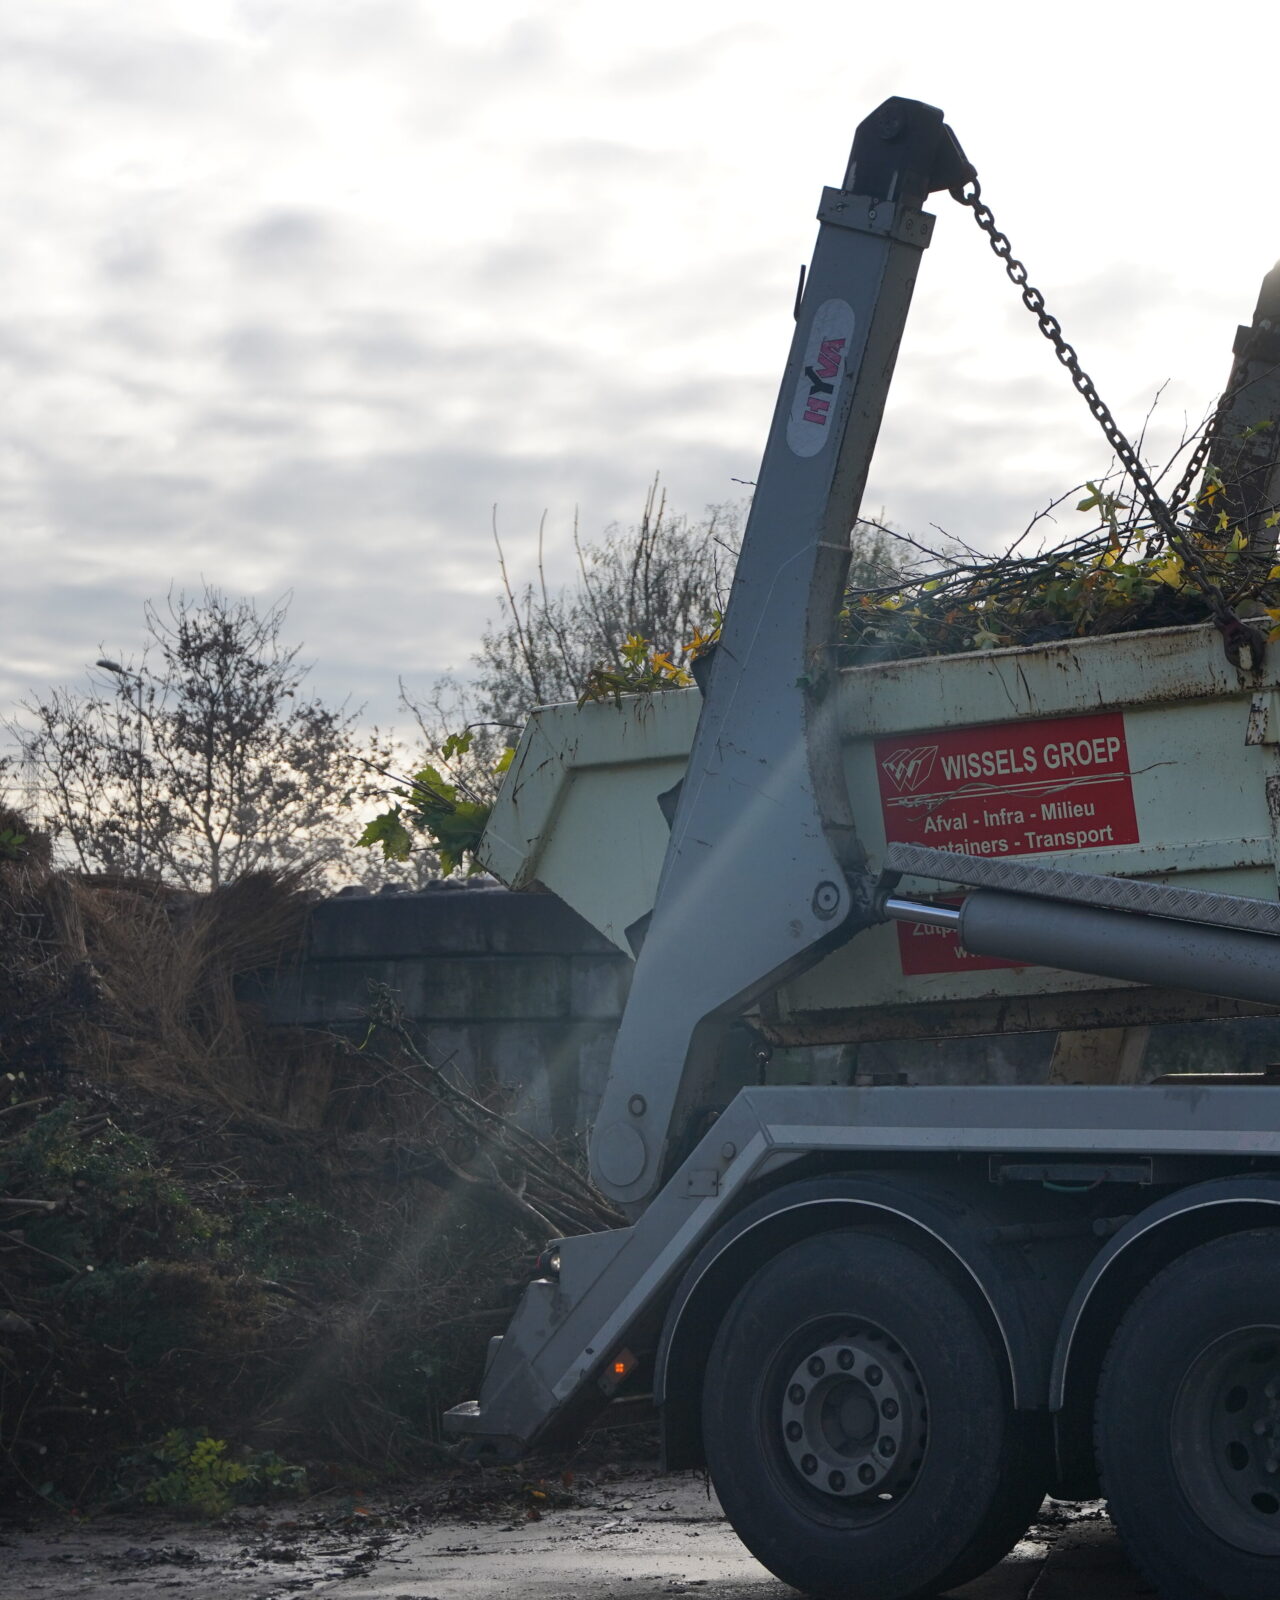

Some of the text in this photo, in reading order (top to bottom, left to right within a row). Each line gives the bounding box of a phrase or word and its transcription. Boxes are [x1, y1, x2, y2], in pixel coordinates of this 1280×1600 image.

[802, 338, 847, 426] HYVA
[941, 736, 1121, 781] WISSELS GROEP
[924, 812, 968, 834] Afval
[984, 808, 1024, 828] Infra
[1041, 801, 1095, 821] Milieu
[1024, 824, 1113, 850] Transport
